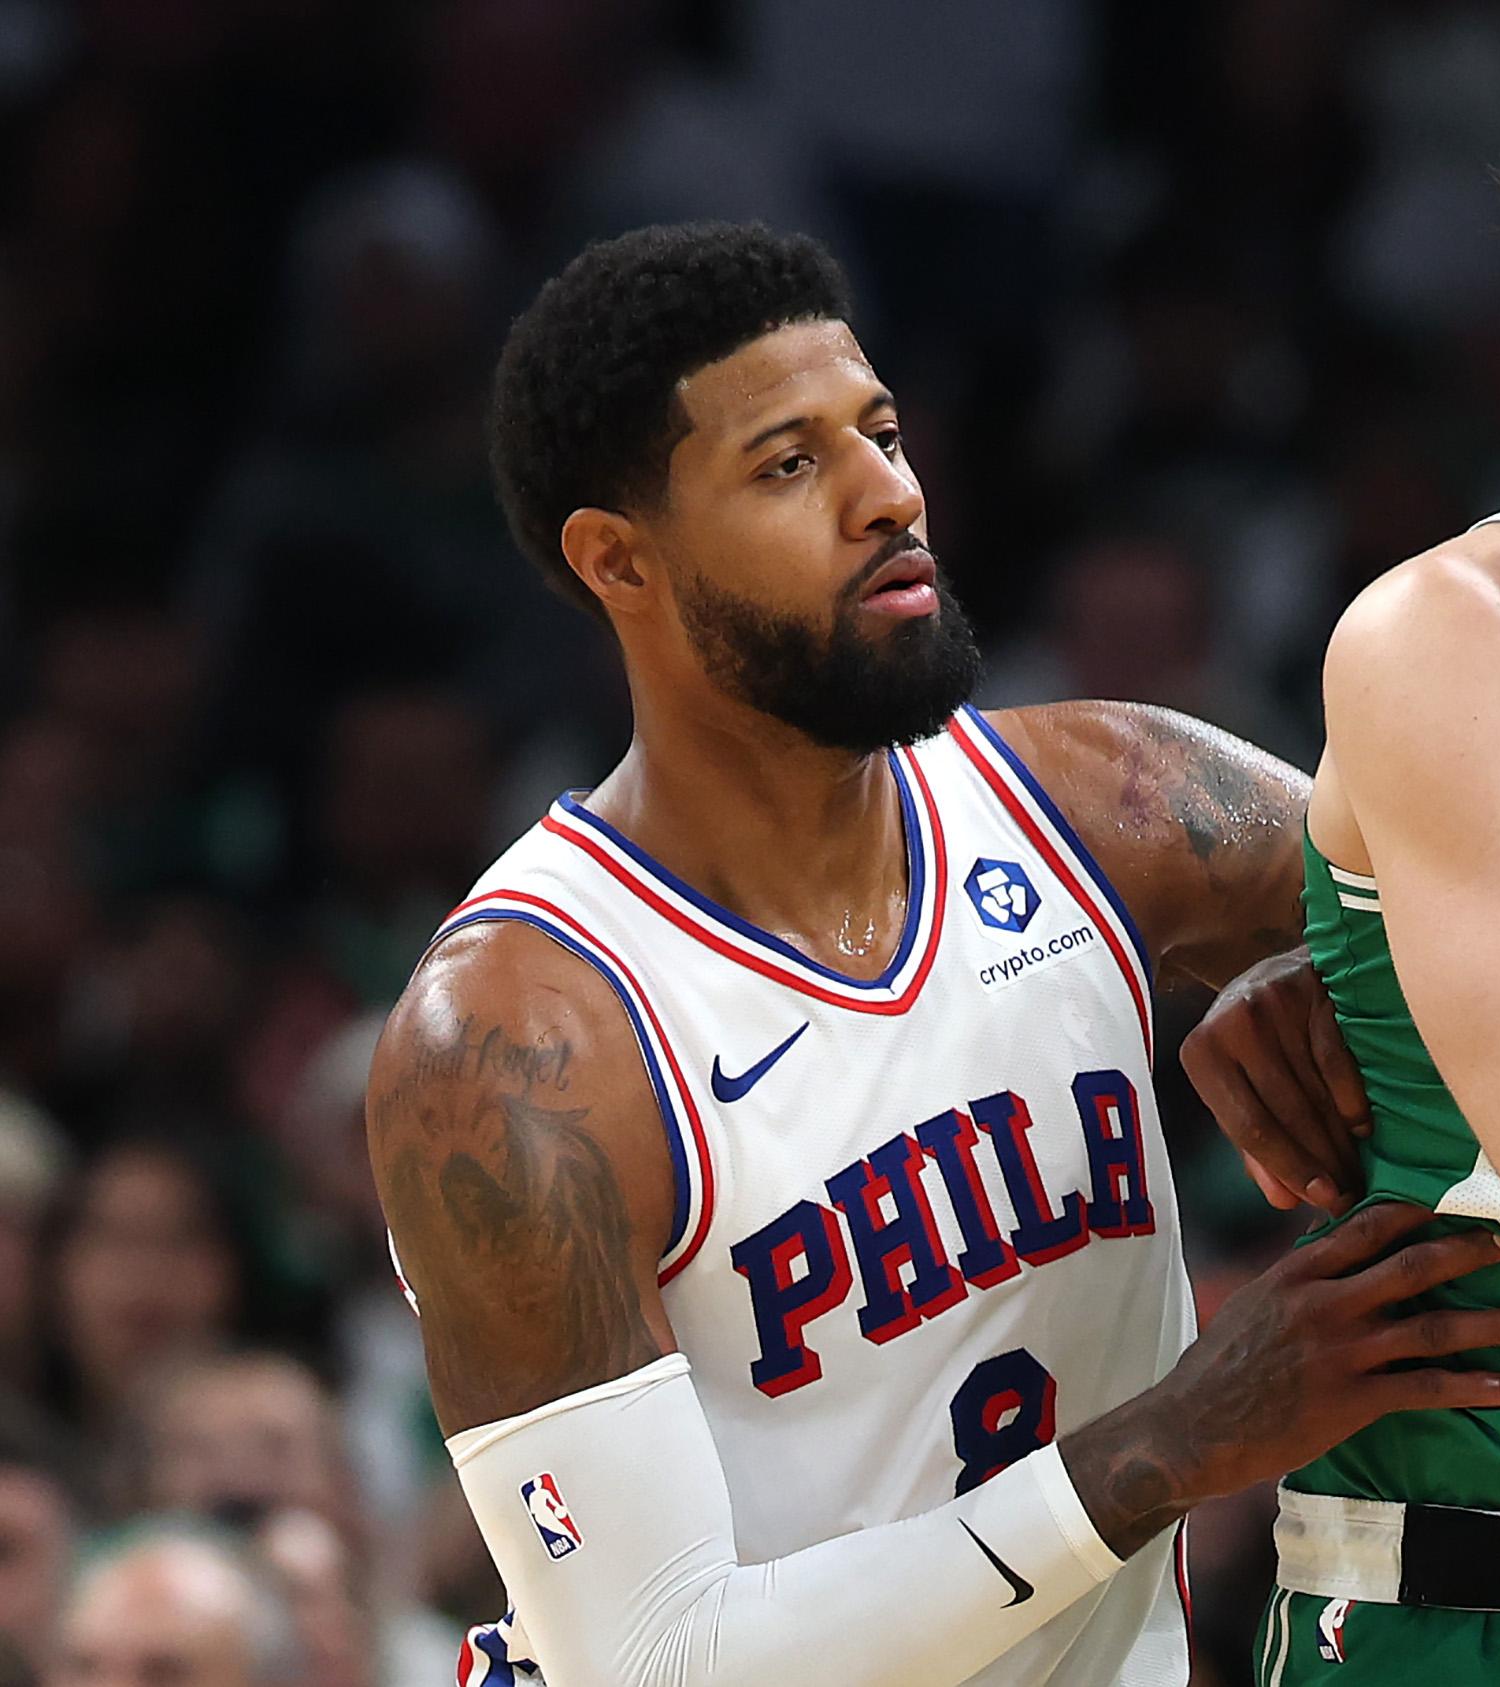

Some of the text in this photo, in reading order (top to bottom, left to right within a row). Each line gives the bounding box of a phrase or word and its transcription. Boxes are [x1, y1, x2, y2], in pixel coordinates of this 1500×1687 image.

[979, 924, 1095, 986] crypto.com
[729, 1069, 1157, 1400] PHILA
[550, 1536, 571, 1557] NBA
